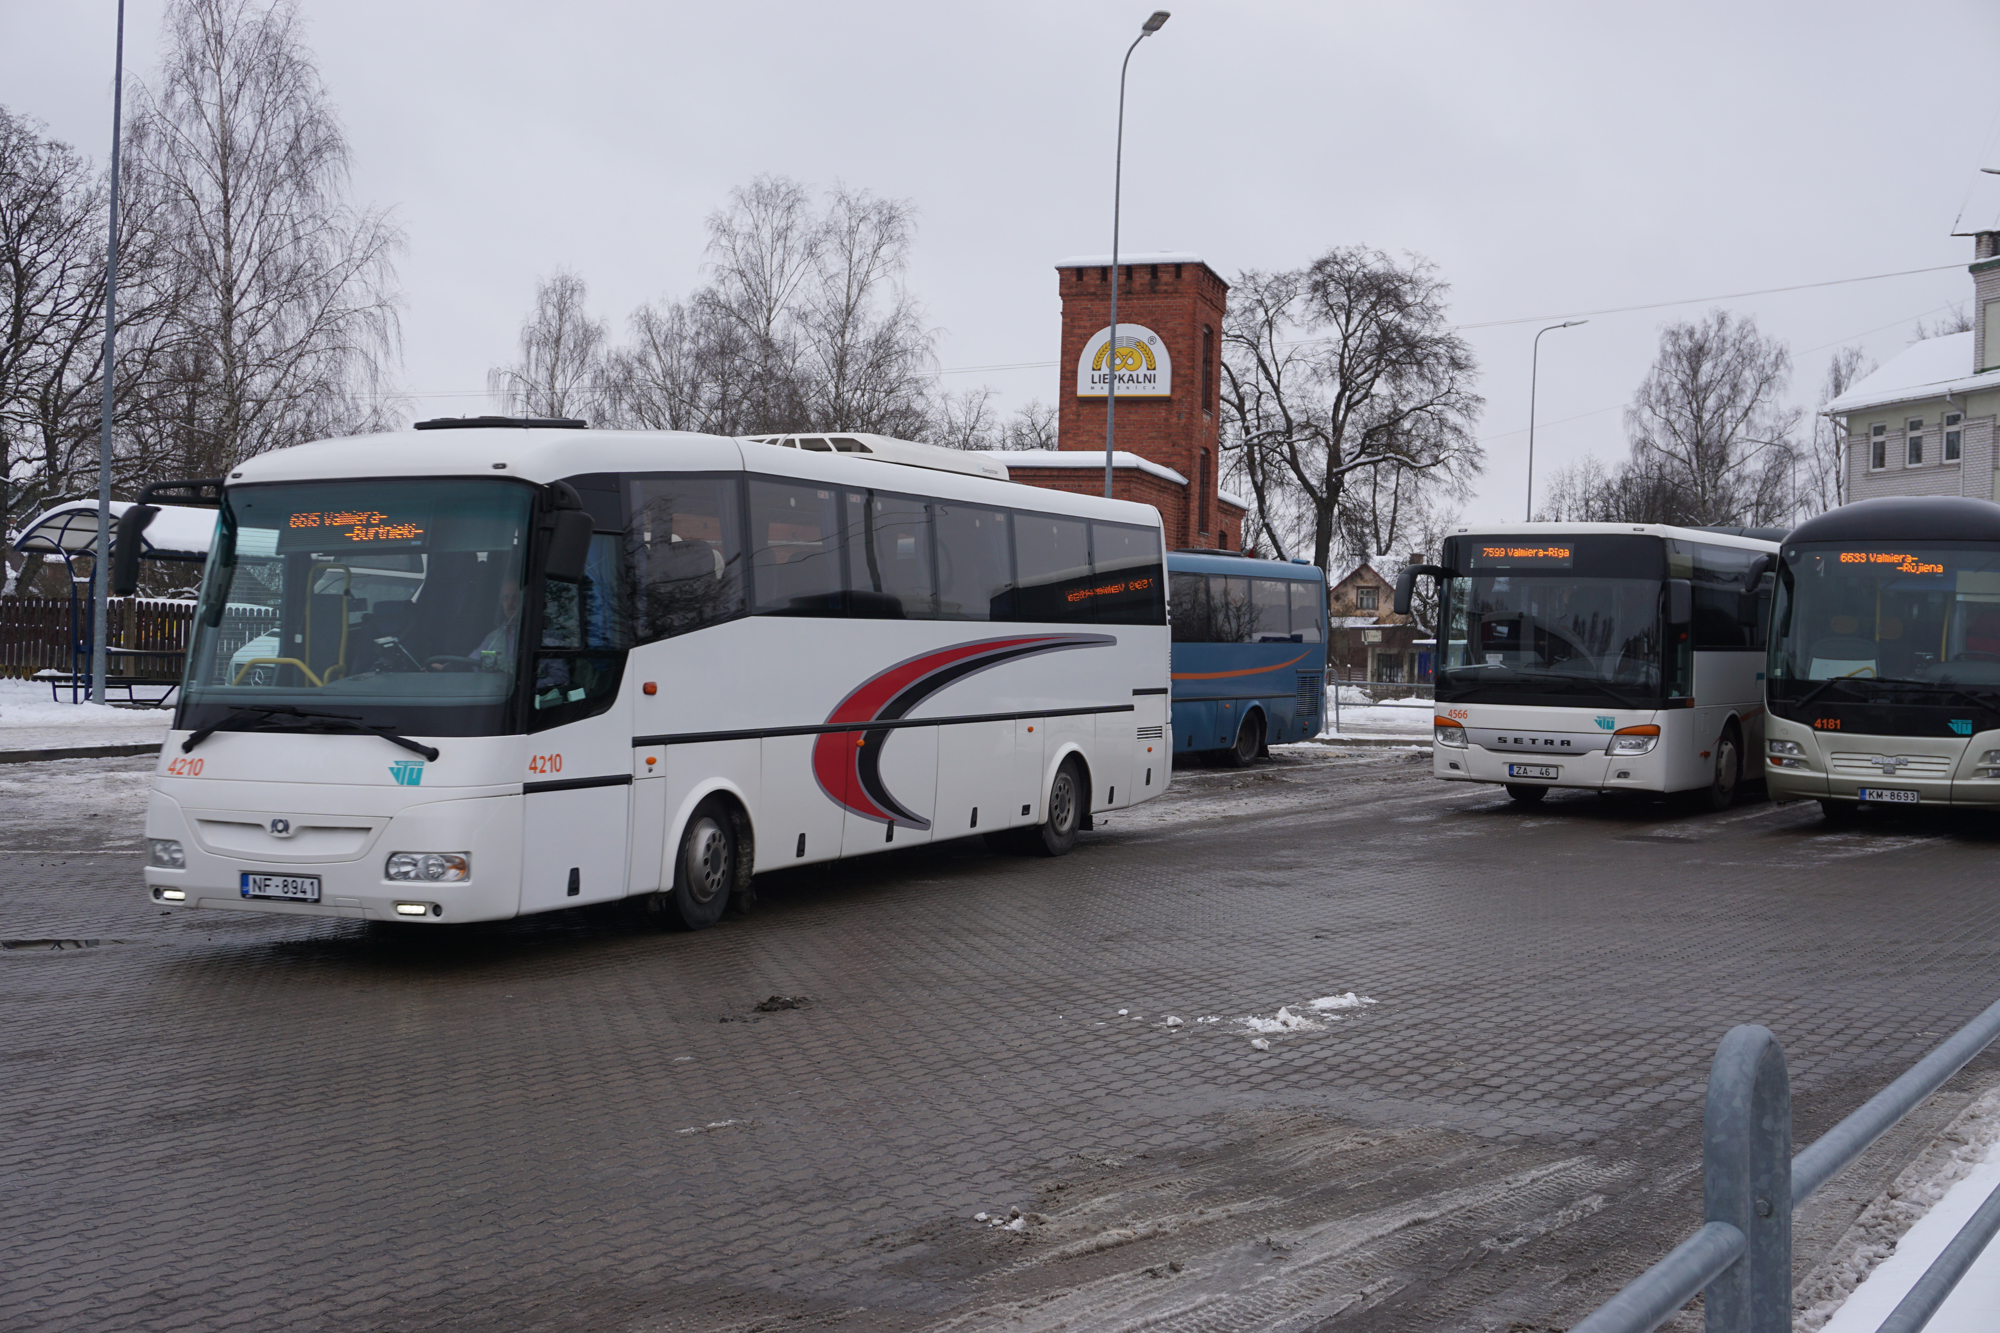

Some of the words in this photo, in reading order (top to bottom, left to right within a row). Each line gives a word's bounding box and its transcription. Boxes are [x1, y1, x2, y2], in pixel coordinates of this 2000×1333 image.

[1482, 547, 1506, 557] 7599
[1839, 552, 1867, 563] 6633
[1448, 709, 1468, 719] 4566
[1814, 718, 1841, 729] 4181
[1497, 736, 1571, 746] SETRA
[167, 757, 204, 776] 4210
[528, 753, 562, 774] 4210
[1871, 756, 1908, 766] MAN
[1868, 790, 1916, 802] KM-8693
[252, 877, 315, 897] NF-8941
